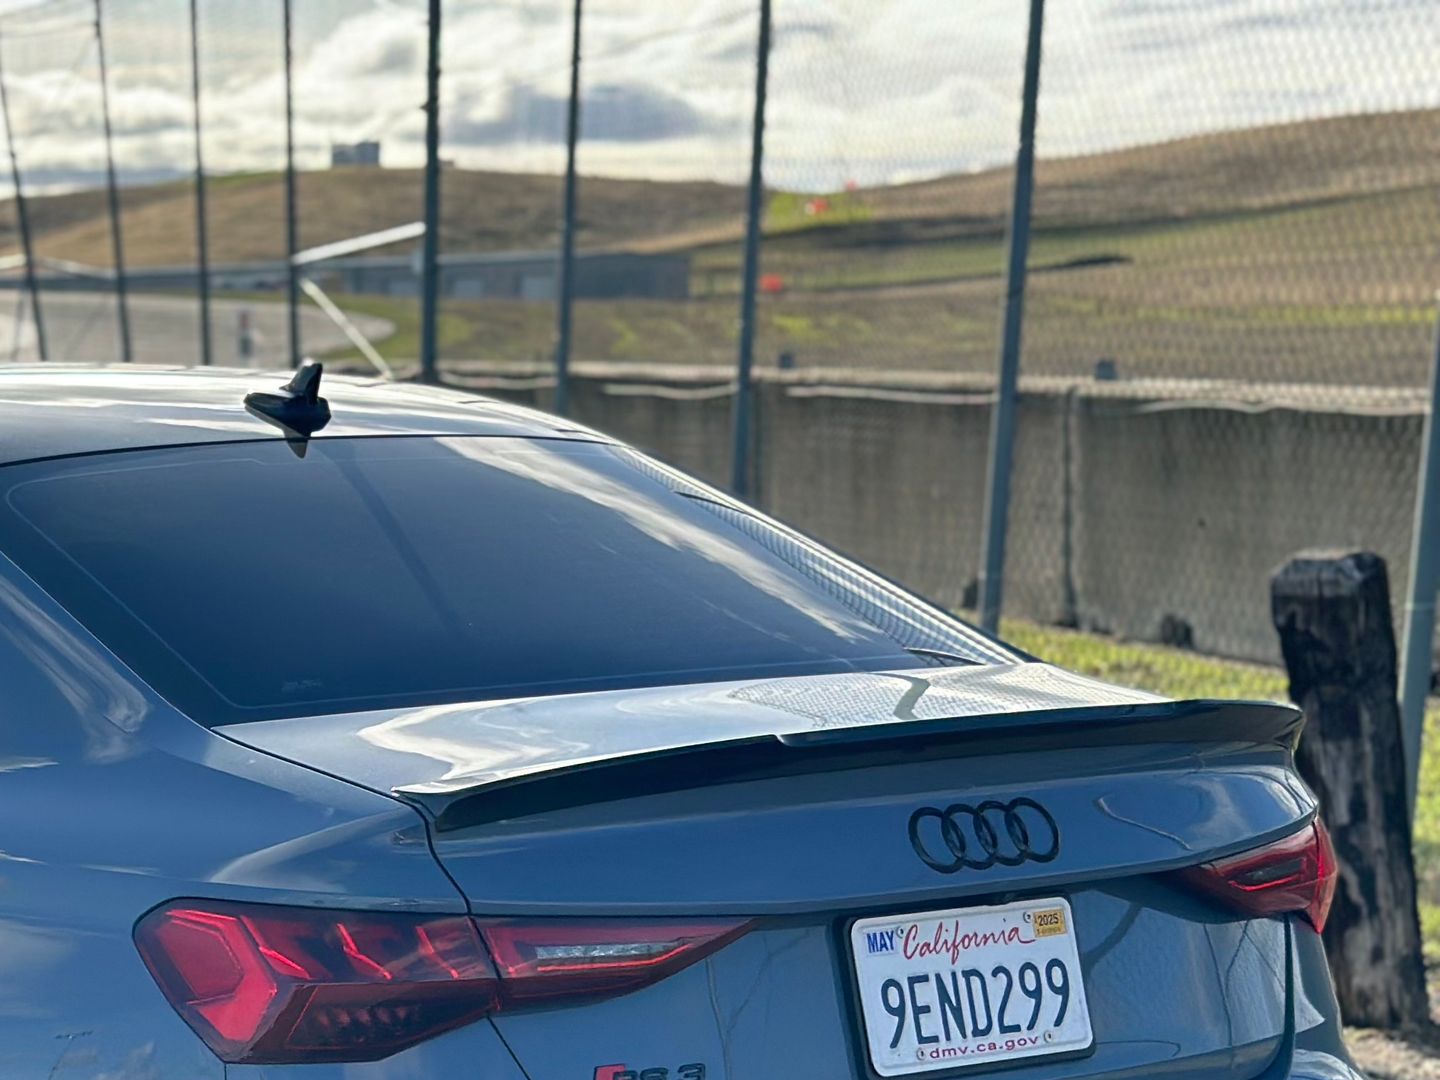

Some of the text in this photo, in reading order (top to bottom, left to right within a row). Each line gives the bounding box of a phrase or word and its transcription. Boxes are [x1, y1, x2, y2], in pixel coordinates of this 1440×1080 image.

[1037, 912, 1059, 927] 2025
[866, 930, 896, 954] MAY
[902, 919, 1037, 966] California
[880, 957, 1070, 1049] 9END299
[929, 1034, 1039, 1060] dmv.ca.gov
